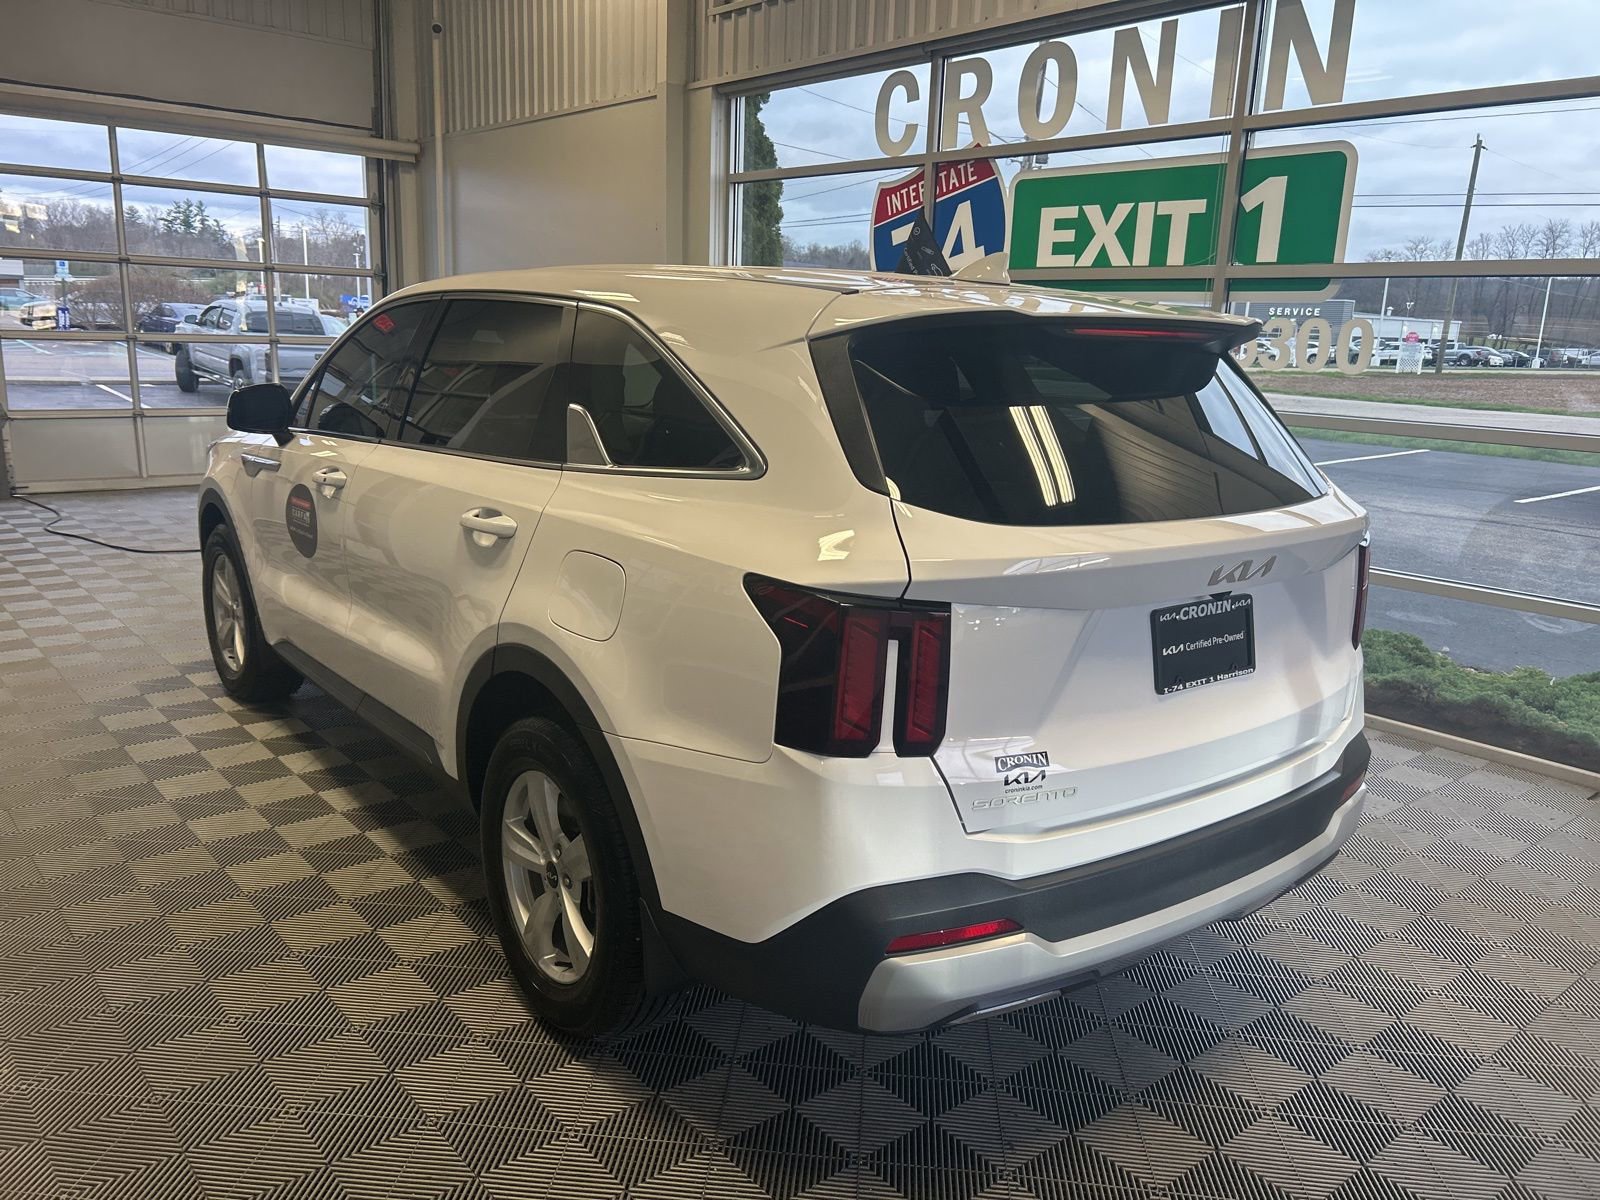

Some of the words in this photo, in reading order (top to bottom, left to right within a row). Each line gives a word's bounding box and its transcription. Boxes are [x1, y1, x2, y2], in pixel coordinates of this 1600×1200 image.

[874, 0, 1356, 157] CRONIN
[1036, 199, 1208, 267] EXIT
[1240, 175, 1288, 263] 1
[1268, 307, 1322, 317] SERVICE
[1207, 555, 1277, 586] KIA
[1179, 599, 1232, 621] CRONIN
[1162, 643, 1184, 656] KIA
[1185, 637, 1212, 651] Certified
[1212, 632, 1244, 646] Pre-Owned
[1163, 683, 1184, 695] I-74
[1185, 677, 1208, 689] EXIT
[1217, 667, 1254, 681] Harrison
[997, 753, 1047, 772] CRONIN
[1003, 769, 1047, 787] KIA
[1004, 784, 1043, 794] croninkia.com
[972, 786, 1078, 809] SORENTO
